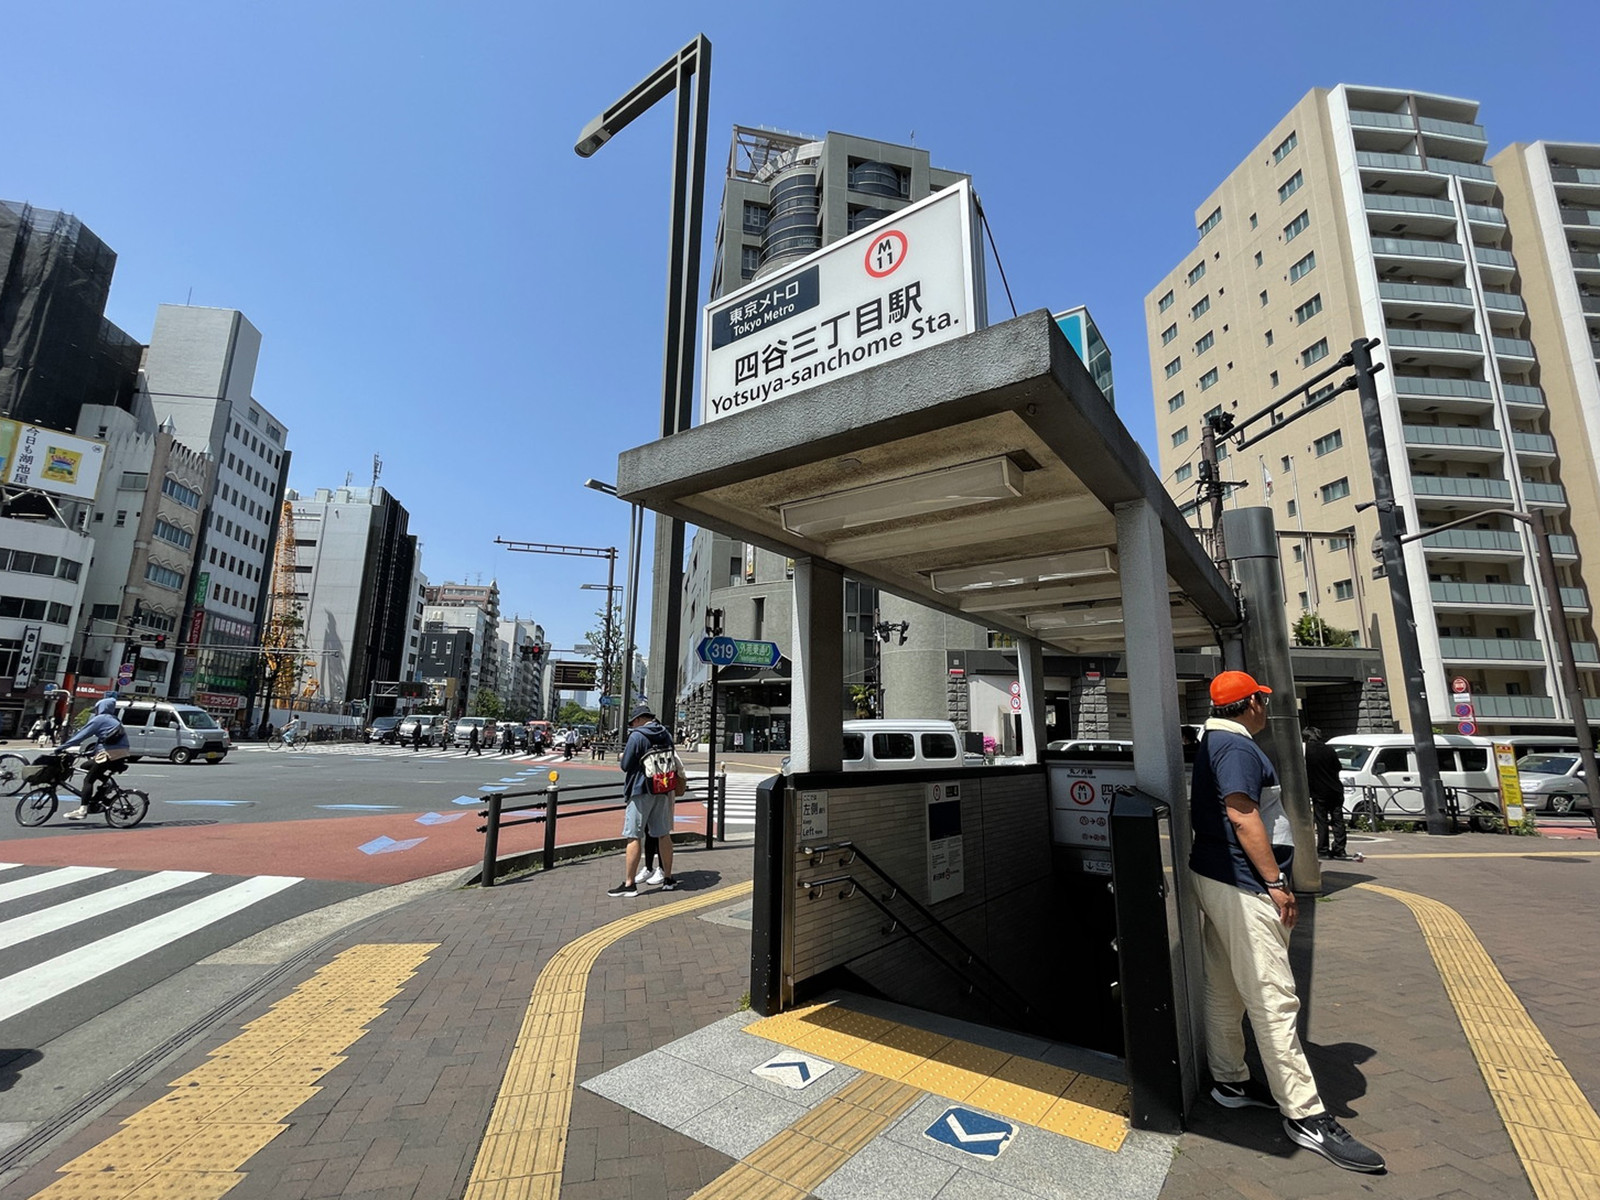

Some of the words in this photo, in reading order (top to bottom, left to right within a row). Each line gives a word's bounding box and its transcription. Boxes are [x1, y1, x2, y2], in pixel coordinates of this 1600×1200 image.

[876, 252, 894, 269] 11
[878, 239, 892, 254] M
[728, 280, 799, 326] 東京メトロ
[733, 317, 763, 336] Tokyo
[764, 302, 795, 323] Metro
[734, 280, 923, 386] 四谷三丁目駅
[712, 333, 903, 415] Yotsuya-sanchome
[911, 310, 959, 341] Sta.
[13, 426, 40, 485] 今日も湖池屋
[19, 634, 35, 676] きしめん
[711, 643, 734, 659] 319
[739, 642, 771, 657] 外苑東通り
[803, 826, 815, 837] Left
